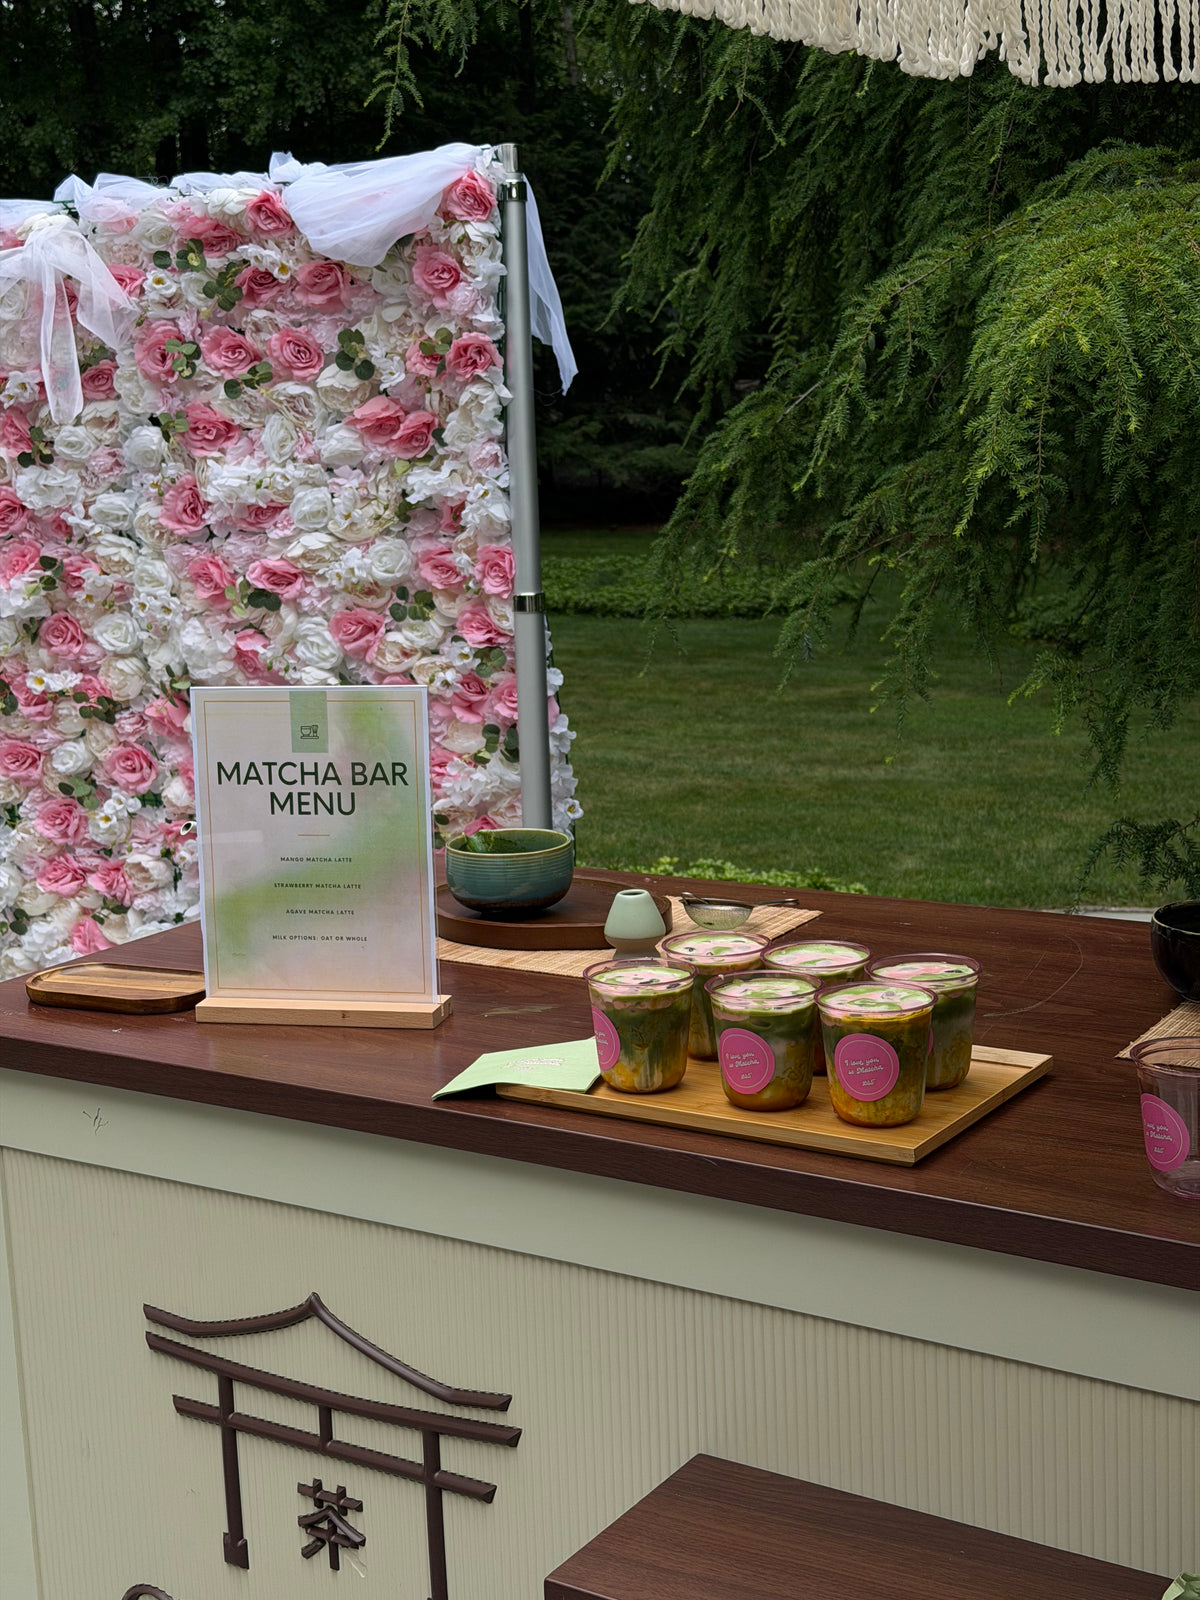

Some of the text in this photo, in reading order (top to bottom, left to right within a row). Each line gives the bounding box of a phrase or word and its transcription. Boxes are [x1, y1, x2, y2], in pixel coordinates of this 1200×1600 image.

[217, 762, 409, 786] MATCHA BAR
[270, 792, 356, 816] MENU
[866, 1058, 880, 1066] you
[297, 1478, 366, 1571] 茶
